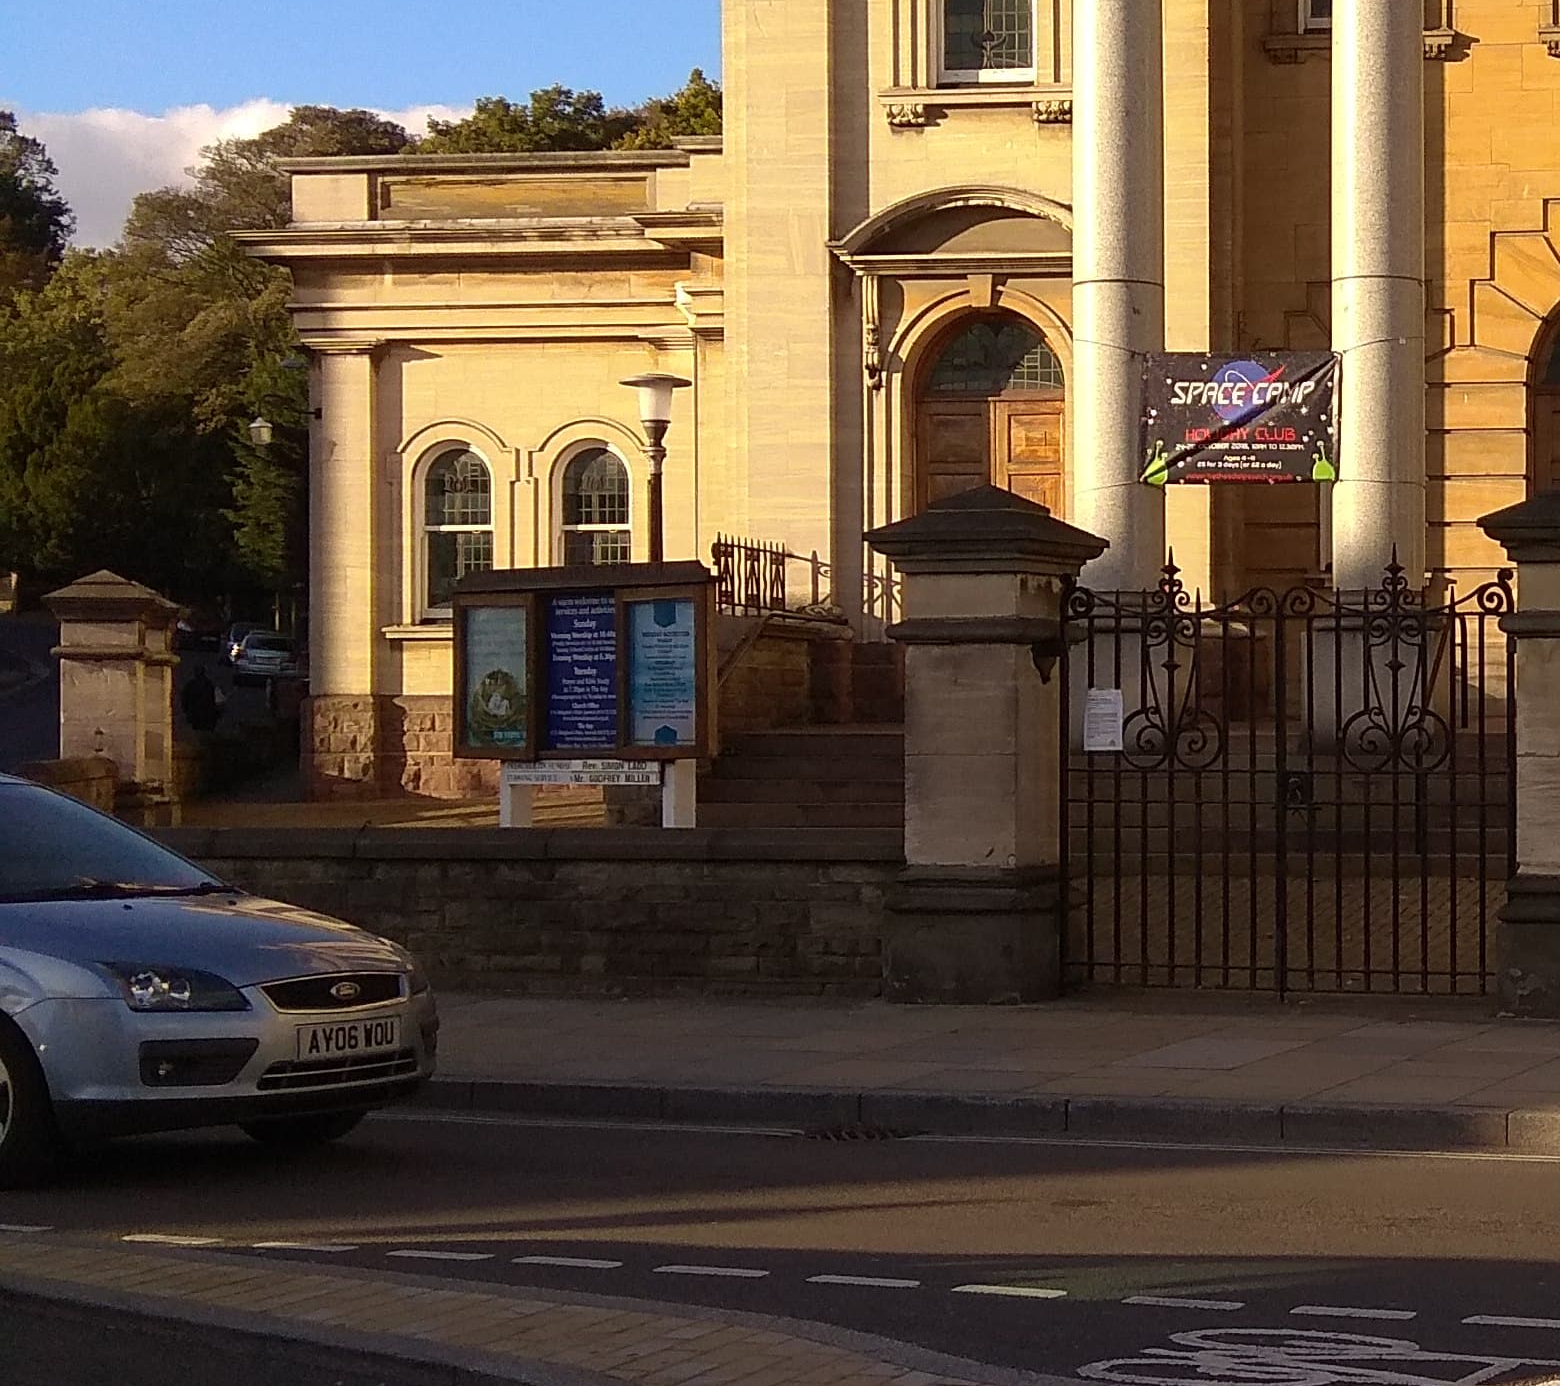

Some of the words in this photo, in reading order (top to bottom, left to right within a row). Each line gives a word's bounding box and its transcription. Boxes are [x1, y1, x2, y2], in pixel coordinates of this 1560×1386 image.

[1170, 381, 1248, 406] SPACE
[1251, 380, 1315, 405] CAMP
[1255, 427, 1296, 441] CLUB
[1223, 461, 1240, 469] days
[1266, 460, 1282, 470] day)
[573, 618, 597, 630] Sunday
[573, 666, 597, 677] Tuesday
[308, 1025, 359, 1054] AY06
